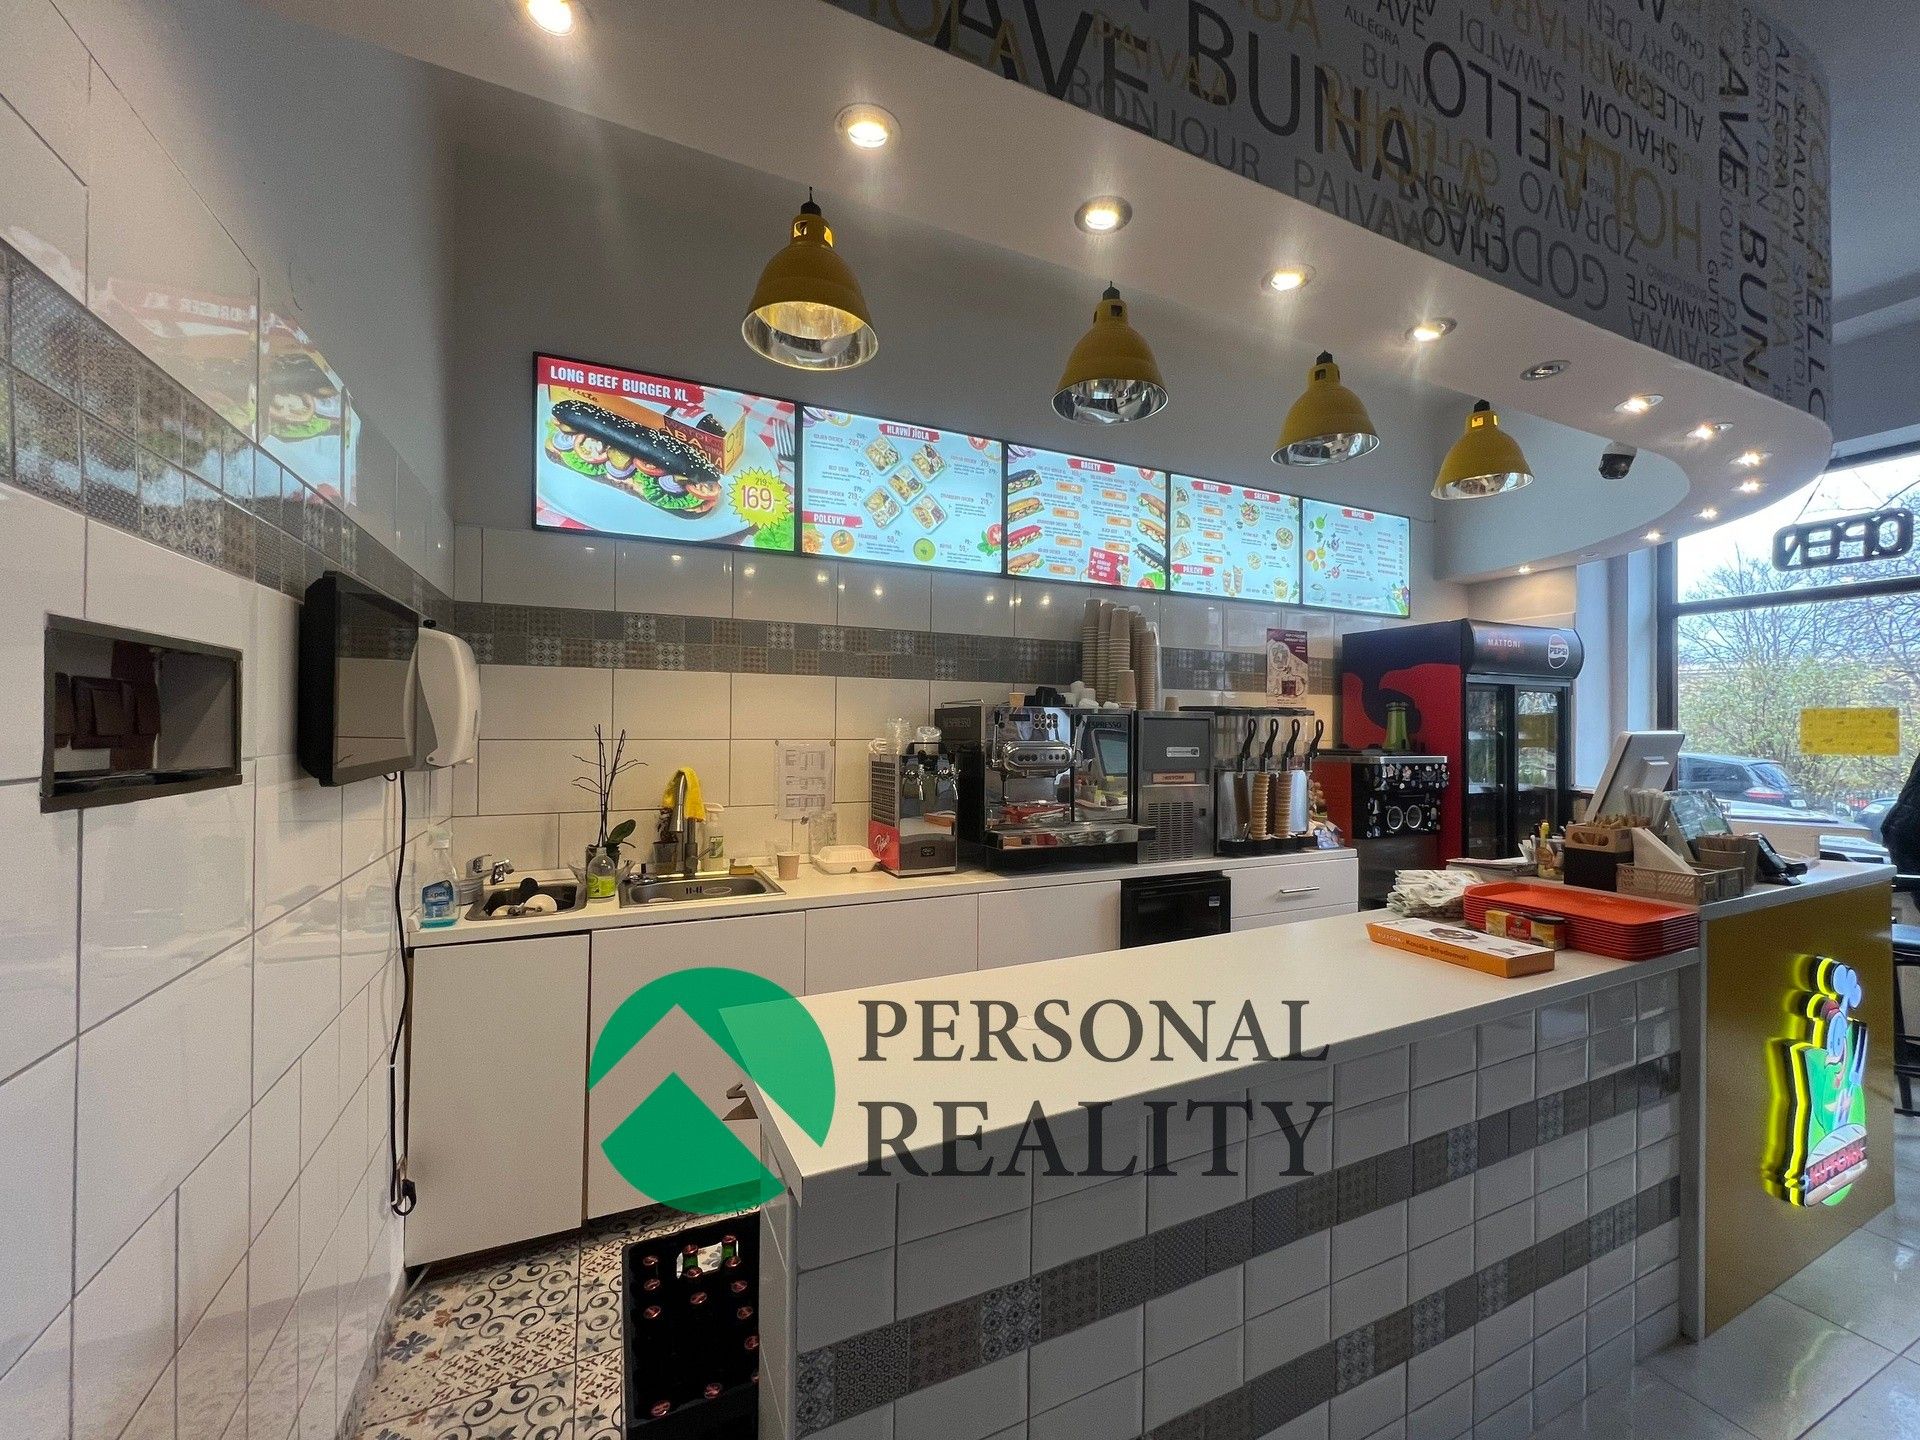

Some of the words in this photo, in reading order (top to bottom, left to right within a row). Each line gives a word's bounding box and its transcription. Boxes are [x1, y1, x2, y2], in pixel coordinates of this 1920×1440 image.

[1344, 6, 1400, 48] ALLEGRA
[1069, 64, 1261, 184] BONJOUR
[1581, 86, 1678, 175] SHALOM
[1718, 46, 1749, 198] AVE
[1625, 272, 1709, 334] NAMASTE
[1738, 221, 1769, 389] BUN
[550, 365, 584, 384] LONG
[587, 372, 618, 390] BEEF
[622, 378, 672, 400] BURGER
[674, 387, 689, 402] XL
[886, 423, 910, 439] HLAVNÍ
[911, 426, 930, 442] JÍDLA
[1487, 638, 1521, 649] MATTONI
[1549, 646, 1568, 656] PEPSI
